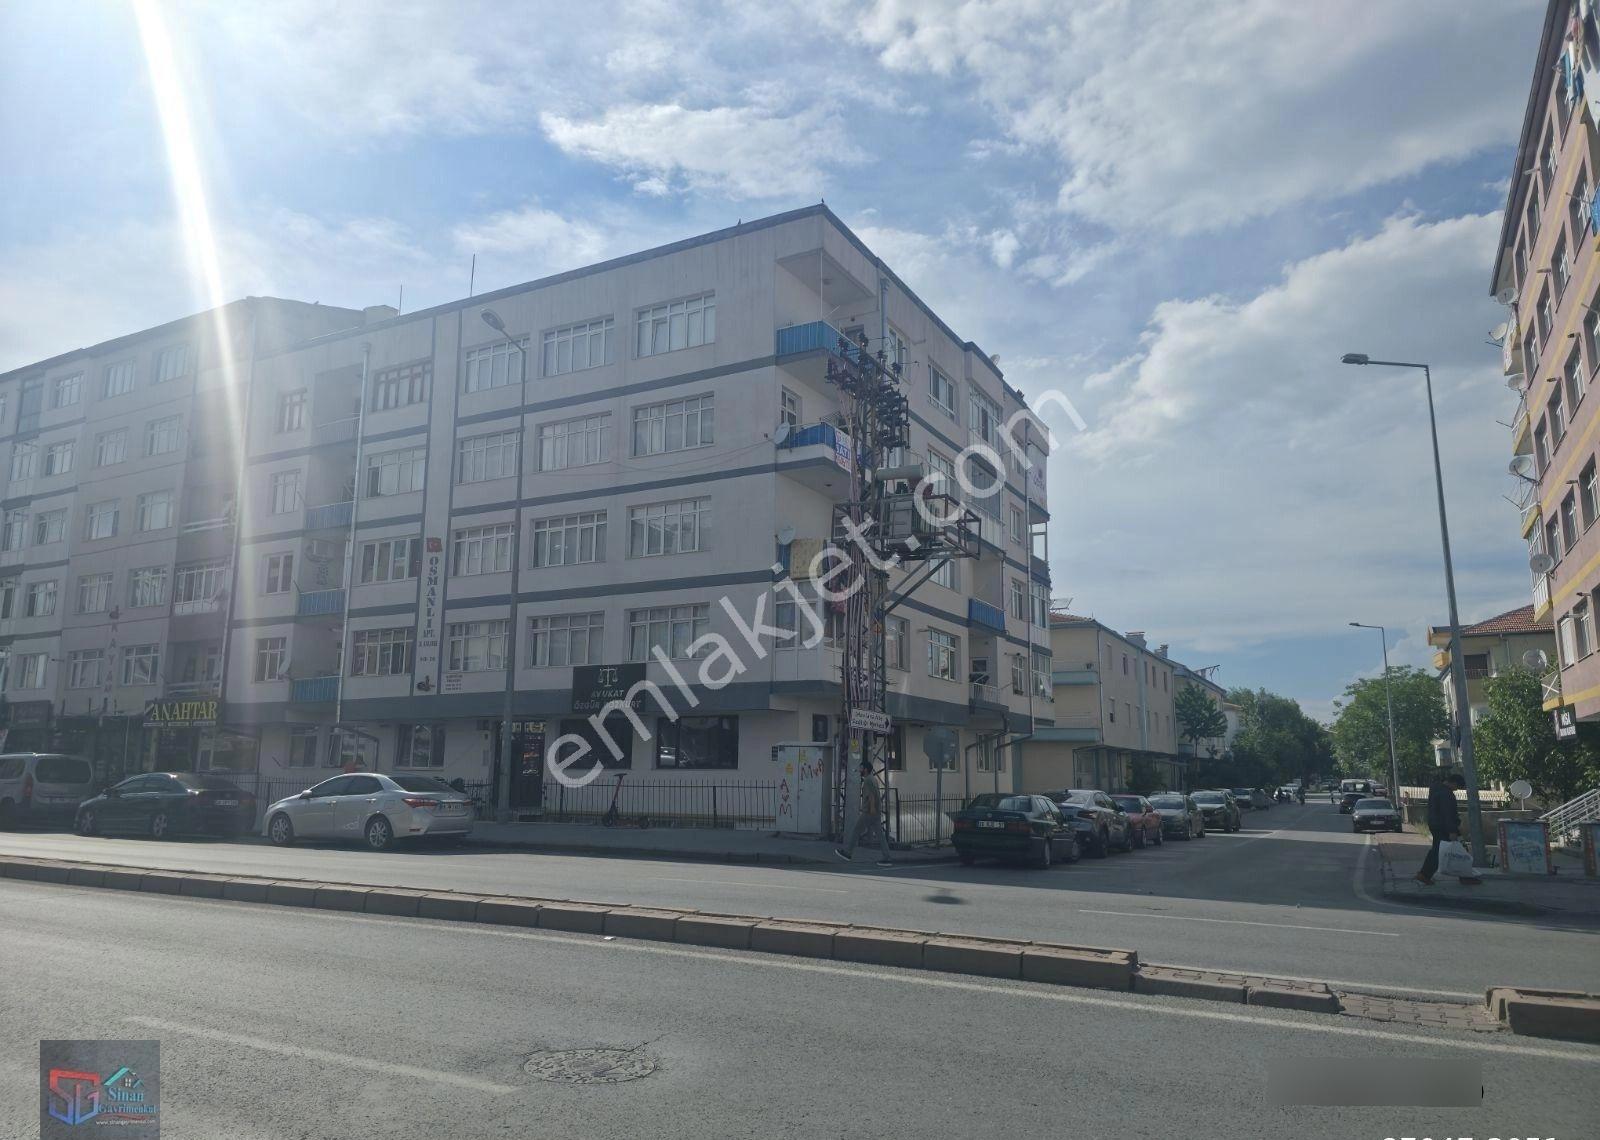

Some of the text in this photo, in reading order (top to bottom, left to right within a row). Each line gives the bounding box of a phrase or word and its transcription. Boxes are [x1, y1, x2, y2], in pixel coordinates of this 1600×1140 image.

[426, 556, 439, 628] OSMANLI
[591, 689, 625, 699] AVUKAT
[150, 701, 217, 721] ANAHTAR
